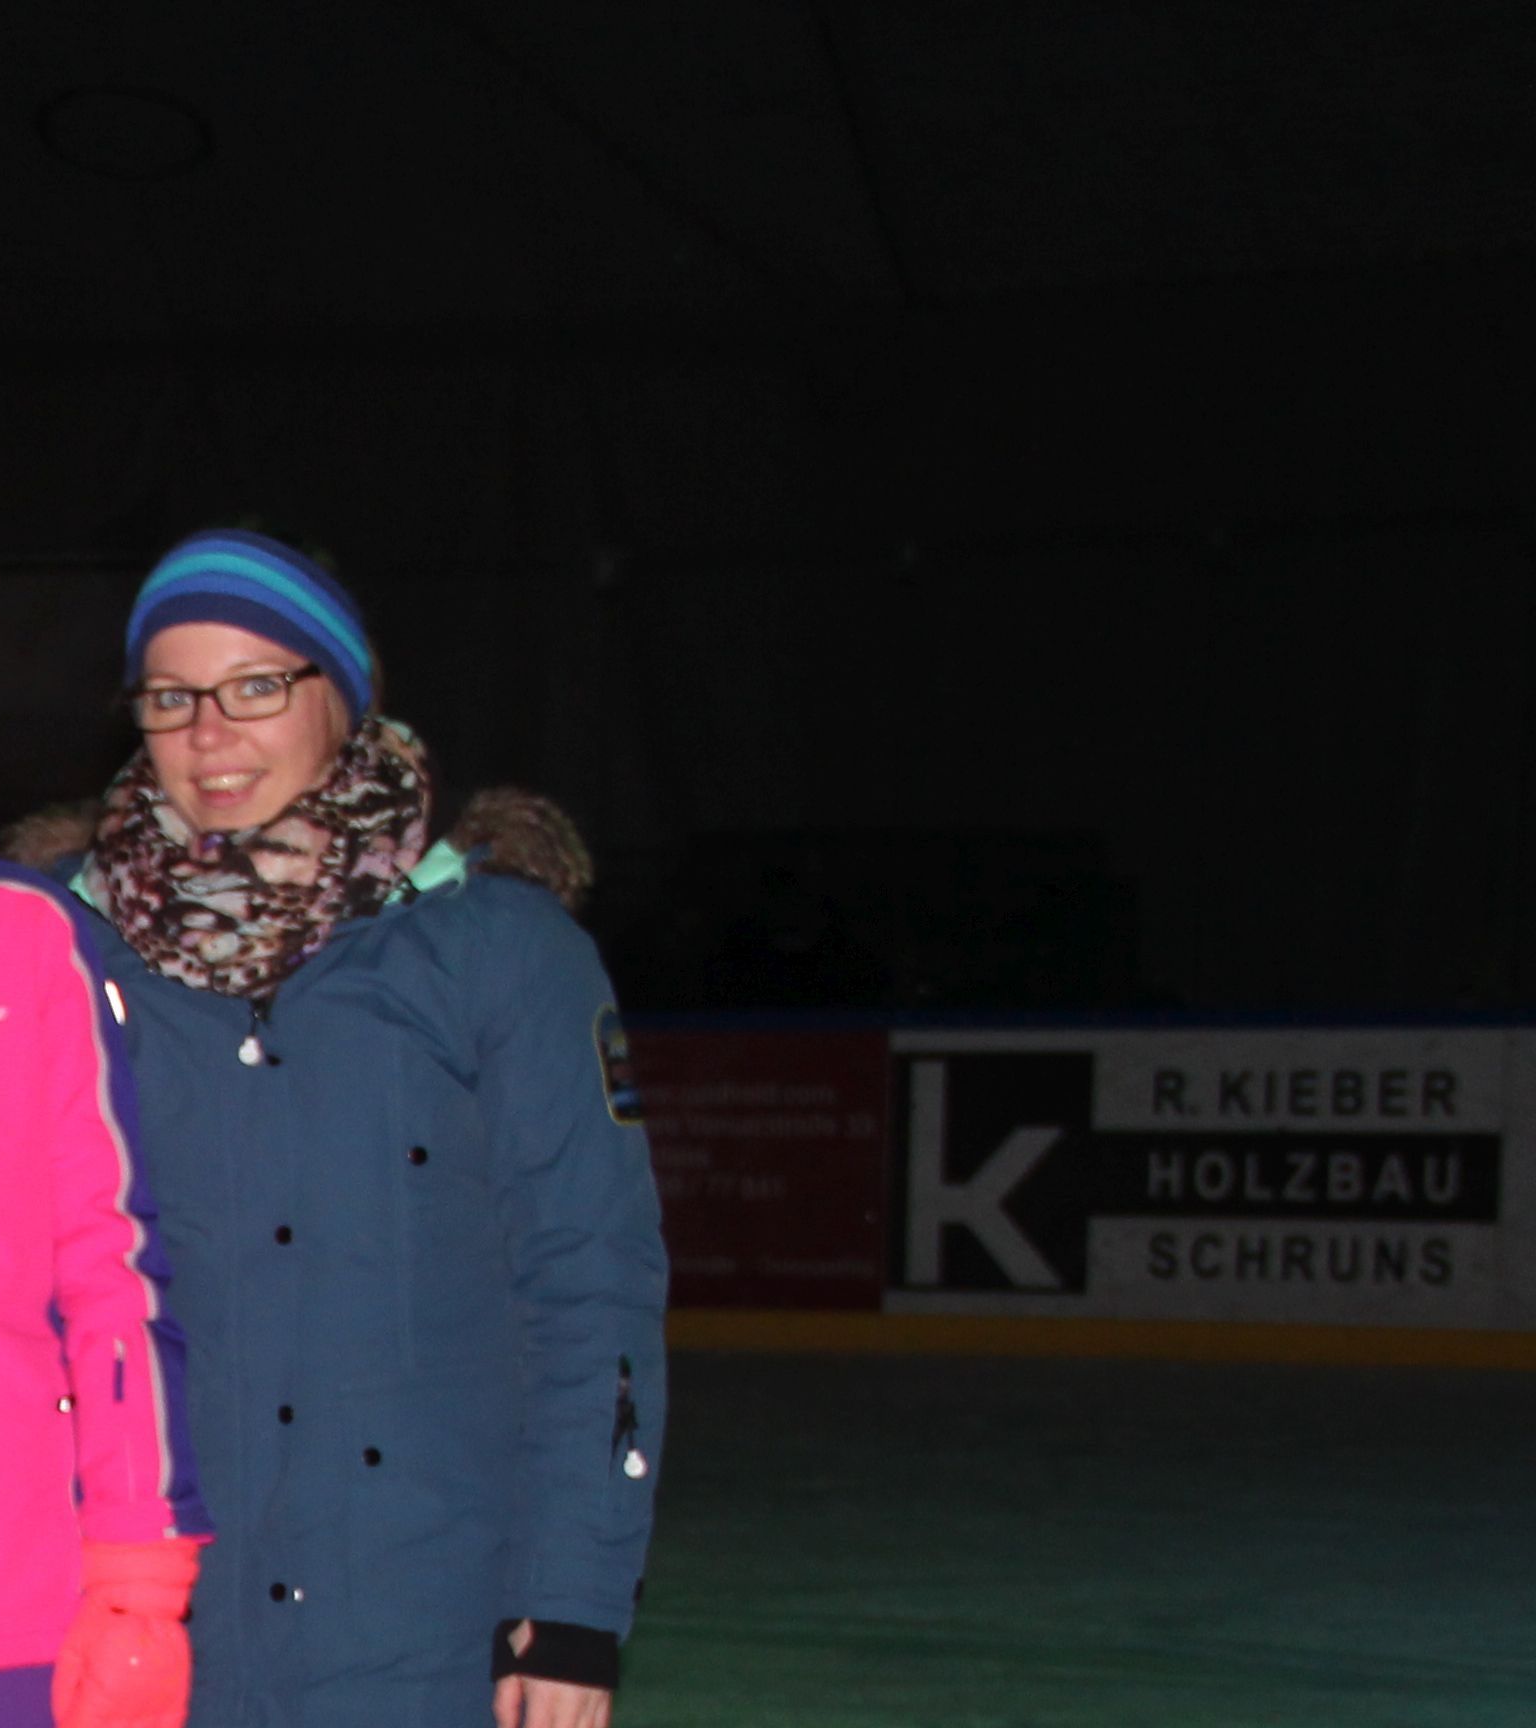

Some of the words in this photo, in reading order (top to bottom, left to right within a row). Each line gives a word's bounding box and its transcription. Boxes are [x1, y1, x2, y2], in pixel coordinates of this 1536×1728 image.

[1152, 1070, 1199, 1117] R.
[1217, 1070, 1460, 1117] KIEBER
[1147, 1149, 1462, 1205] HOLZBAU
[1147, 1231, 1456, 1285] SCHRUNS
